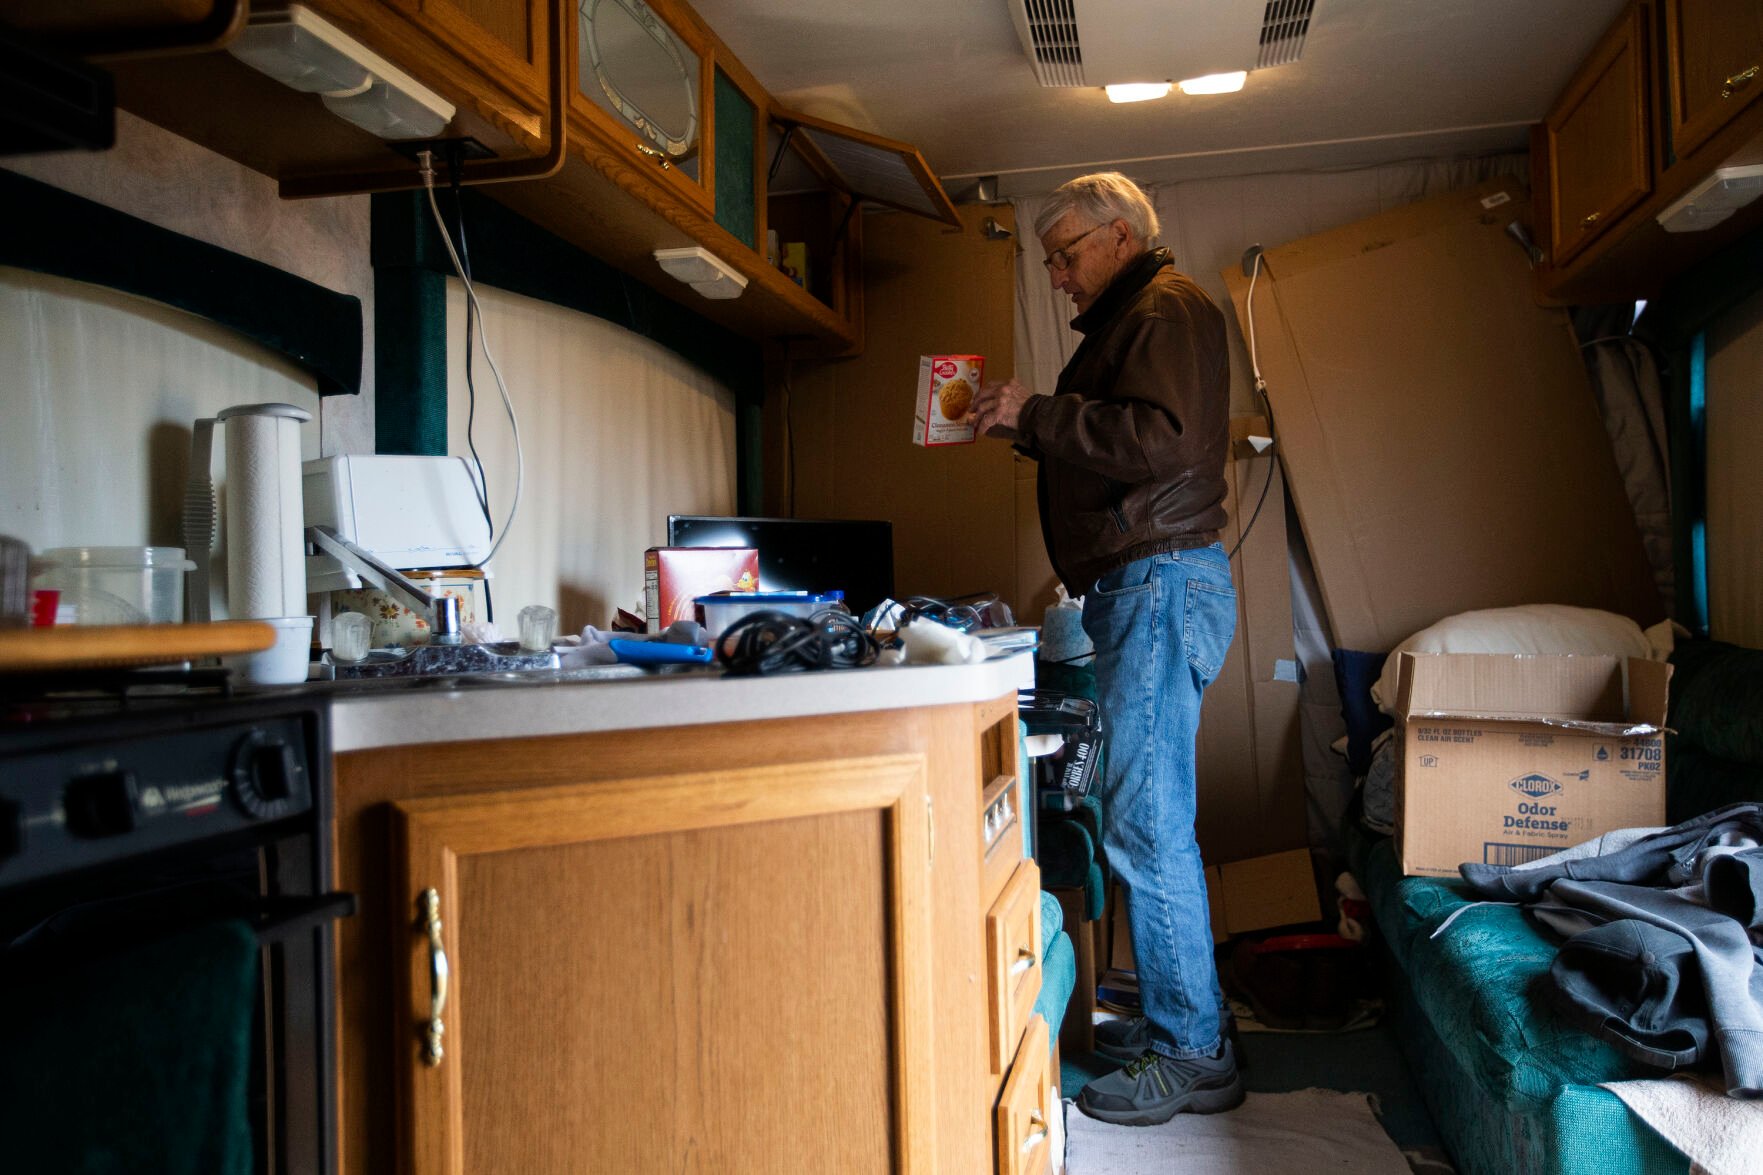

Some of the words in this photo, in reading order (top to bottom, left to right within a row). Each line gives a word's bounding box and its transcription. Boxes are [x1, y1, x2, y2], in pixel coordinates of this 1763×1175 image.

[1453, 729, 1483, 737] BOTTLES
[1453, 736, 1475, 744] SCENT
[1076, 742, 1090, 760] 400
[1620, 746, 1662, 761] 31708
[1423, 757, 1434, 767] UP
[1516, 779, 1556, 793] CLOROX
[1517, 802, 1557, 816] Odor
[1503, 816, 1568, 831] Defense
[1523, 830, 1545, 838] Fabric
